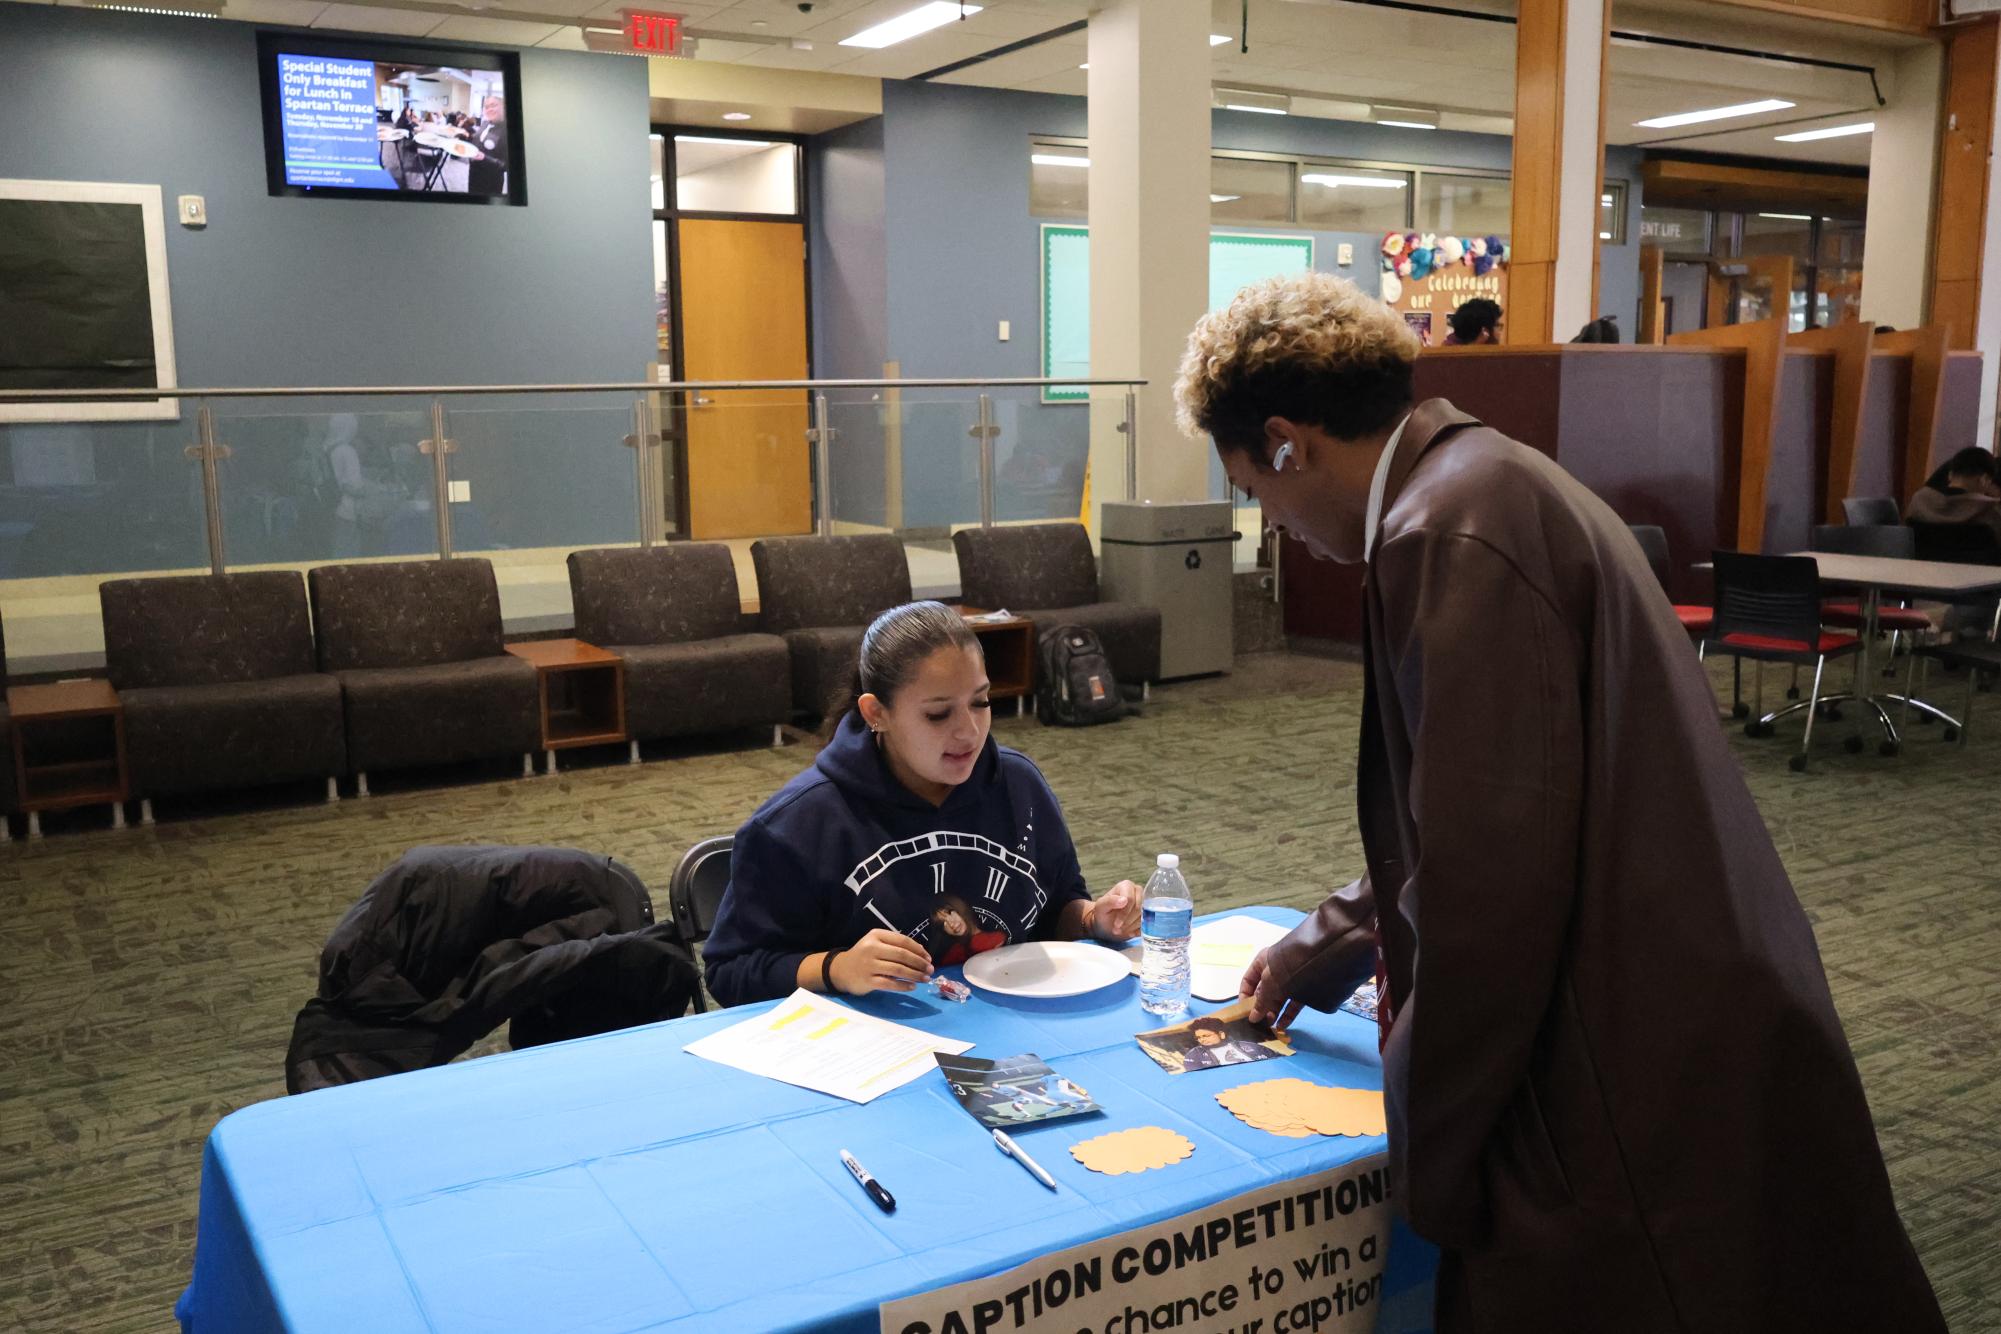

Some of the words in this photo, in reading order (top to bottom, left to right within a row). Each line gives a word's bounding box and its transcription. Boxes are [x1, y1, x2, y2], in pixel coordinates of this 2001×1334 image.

[632, 15, 677, 51] EXIT
[283, 60, 324, 73] Special
[327, 63, 371, 77] Student
[284, 73, 311, 86] Only
[314, 75, 367, 88] Breakfast
[284, 85, 302, 97] for
[303, 87, 339, 99] Lunch
[341, 89, 353, 100] in
[284, 97, 331, 111] Spartan
[332, 100, 375, 114] Terrace
[1662, 223, 1681, 237] LIFE
[1111, 1167, 1392, 1284] COMPETITION!
[1105, 1283, 1239, 1334] chance
[1248, 1265, 1285, 1300] to
[1293, 1243, 1350, 1283] win
[1359, 1234, 1377, 1263] a
